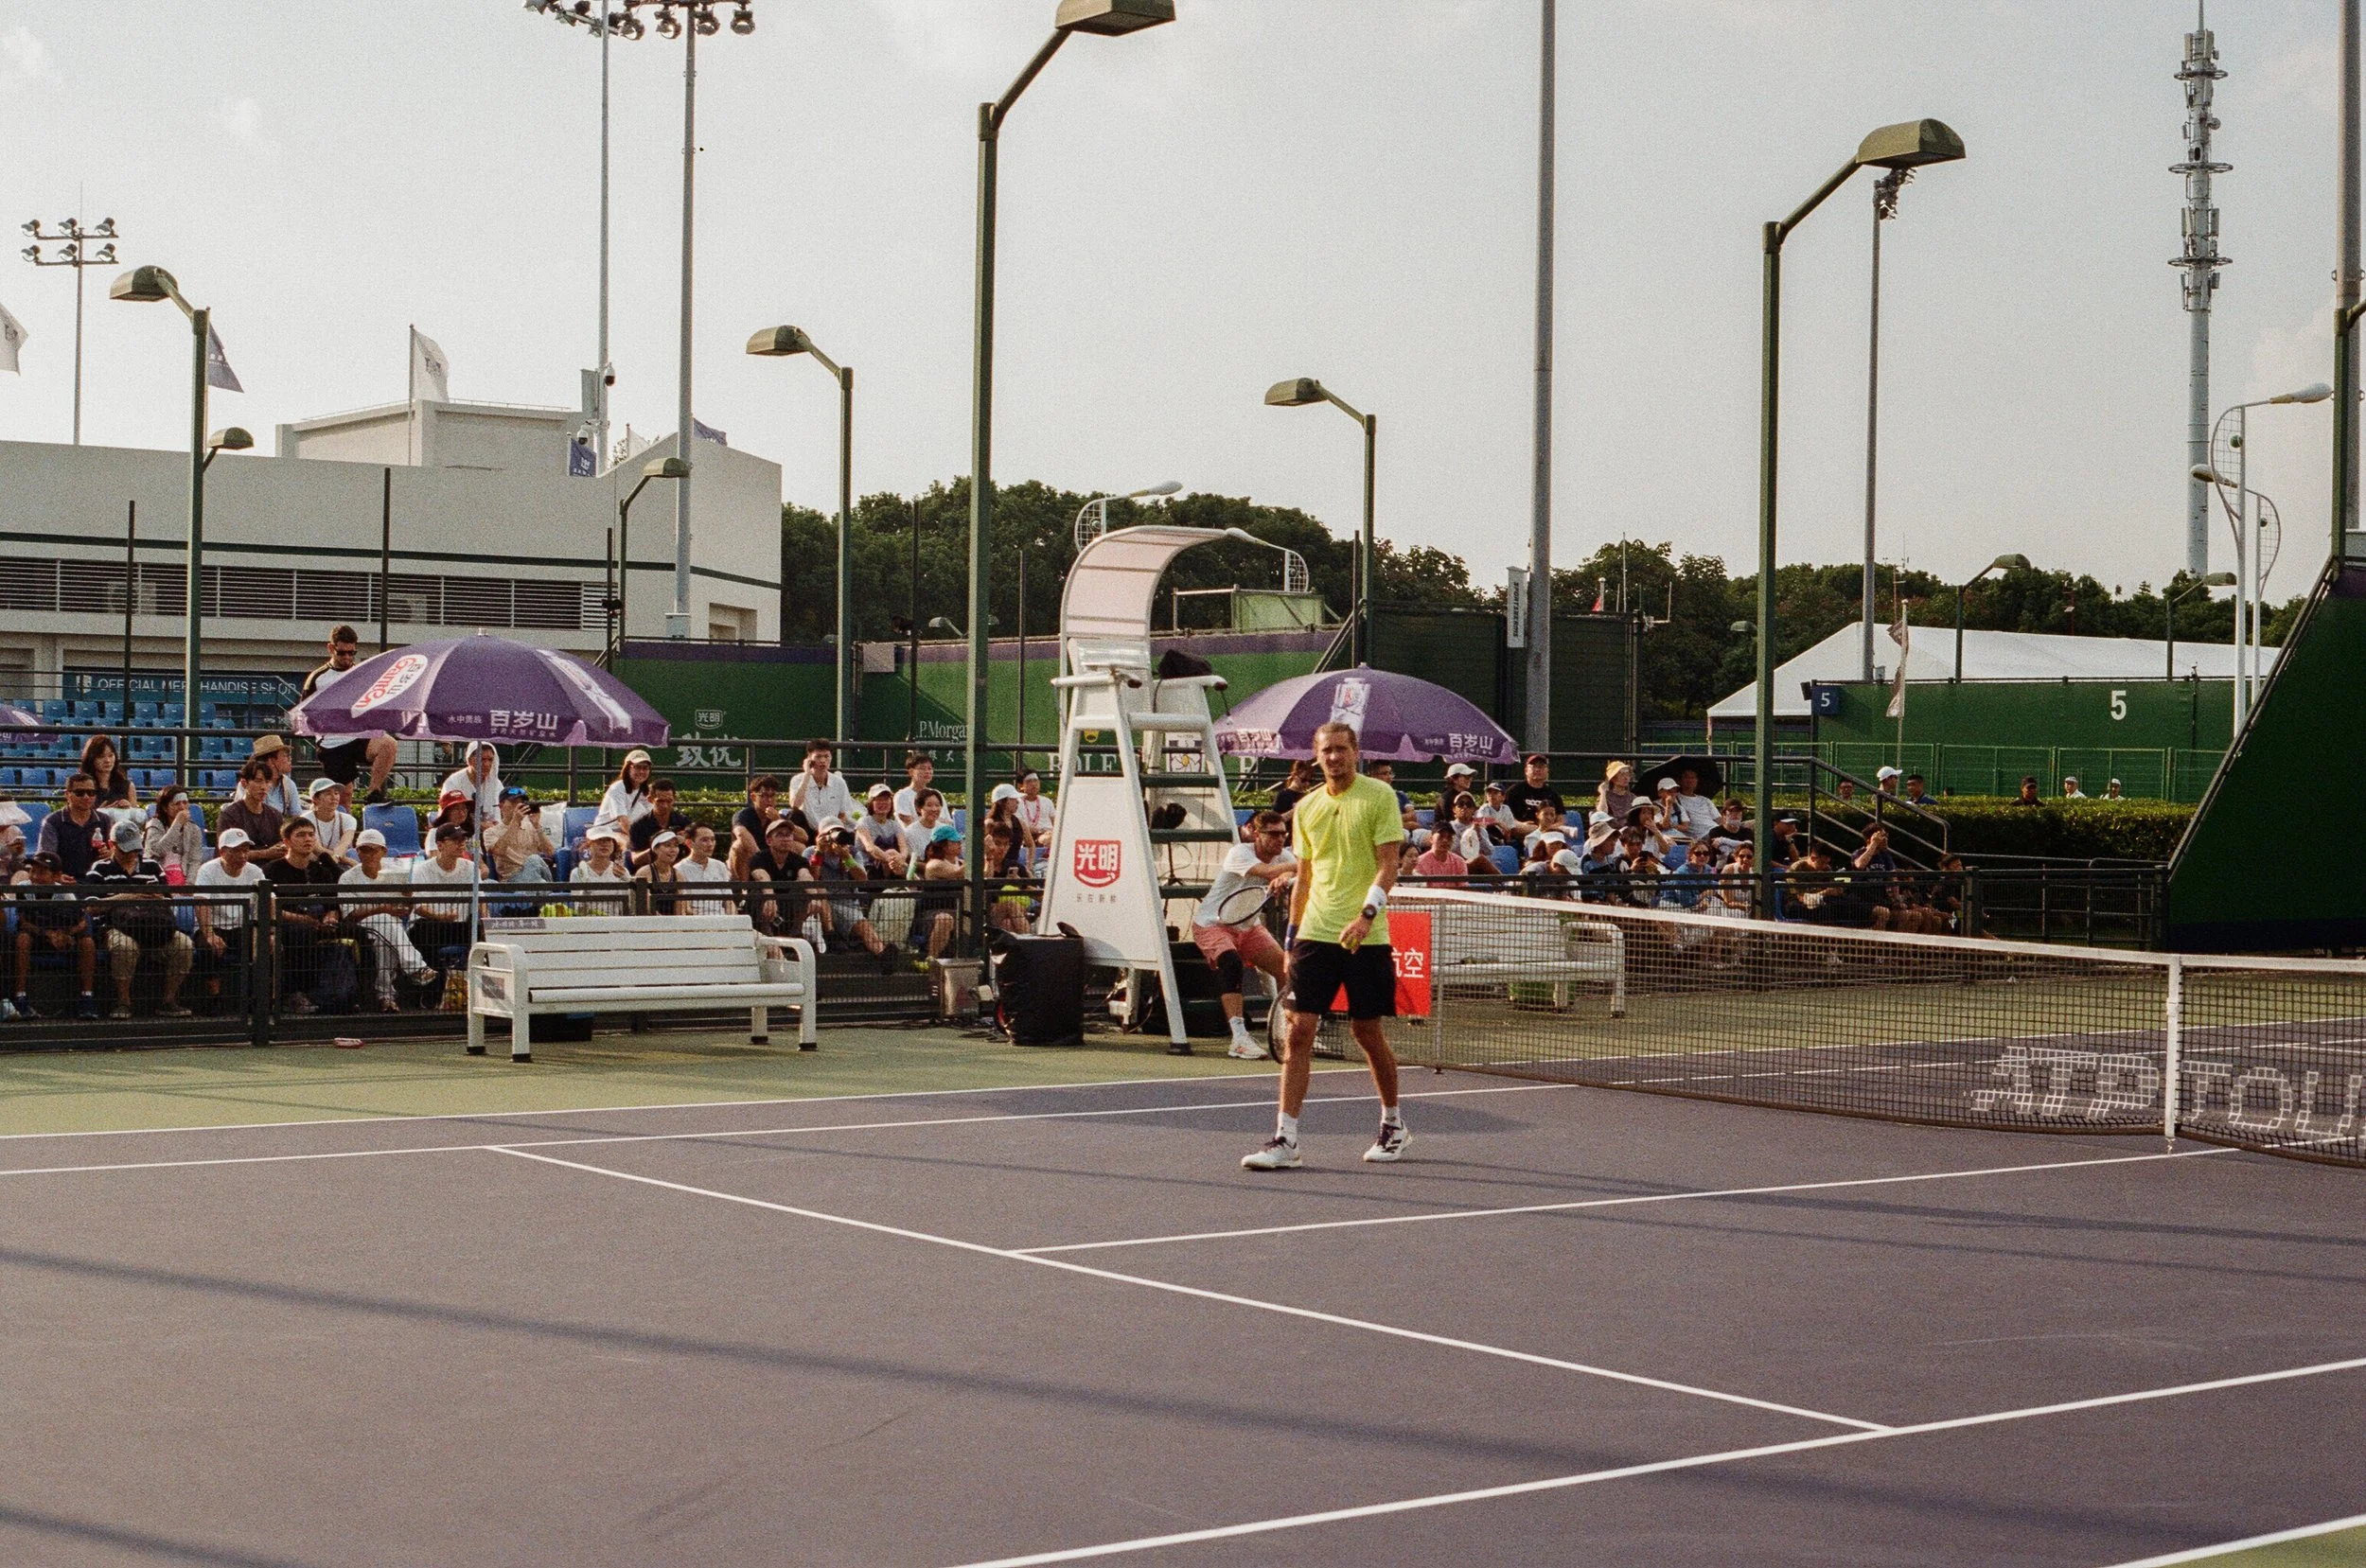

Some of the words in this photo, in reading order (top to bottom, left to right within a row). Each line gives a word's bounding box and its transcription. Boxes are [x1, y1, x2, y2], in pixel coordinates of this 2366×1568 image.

[98, 678, 159, 693] OFFCIAL
[261, 682, 297, 696] SHOP
[354, 658, 416, 708] Ganten
[1821, 692, 1830, 707] 5
[2110, 690, 2127, 721] 5
[490, 710, 558, 730] 百岁山
[697, 712, 720, 723] 光明
[1448, 732, 1493, 749] 百岁山
[1076, 843, 1119, 872] 光明
[1964, 1047, 2160, 1119] ATP
[2182, 1060, 2366, 1141] TOU
